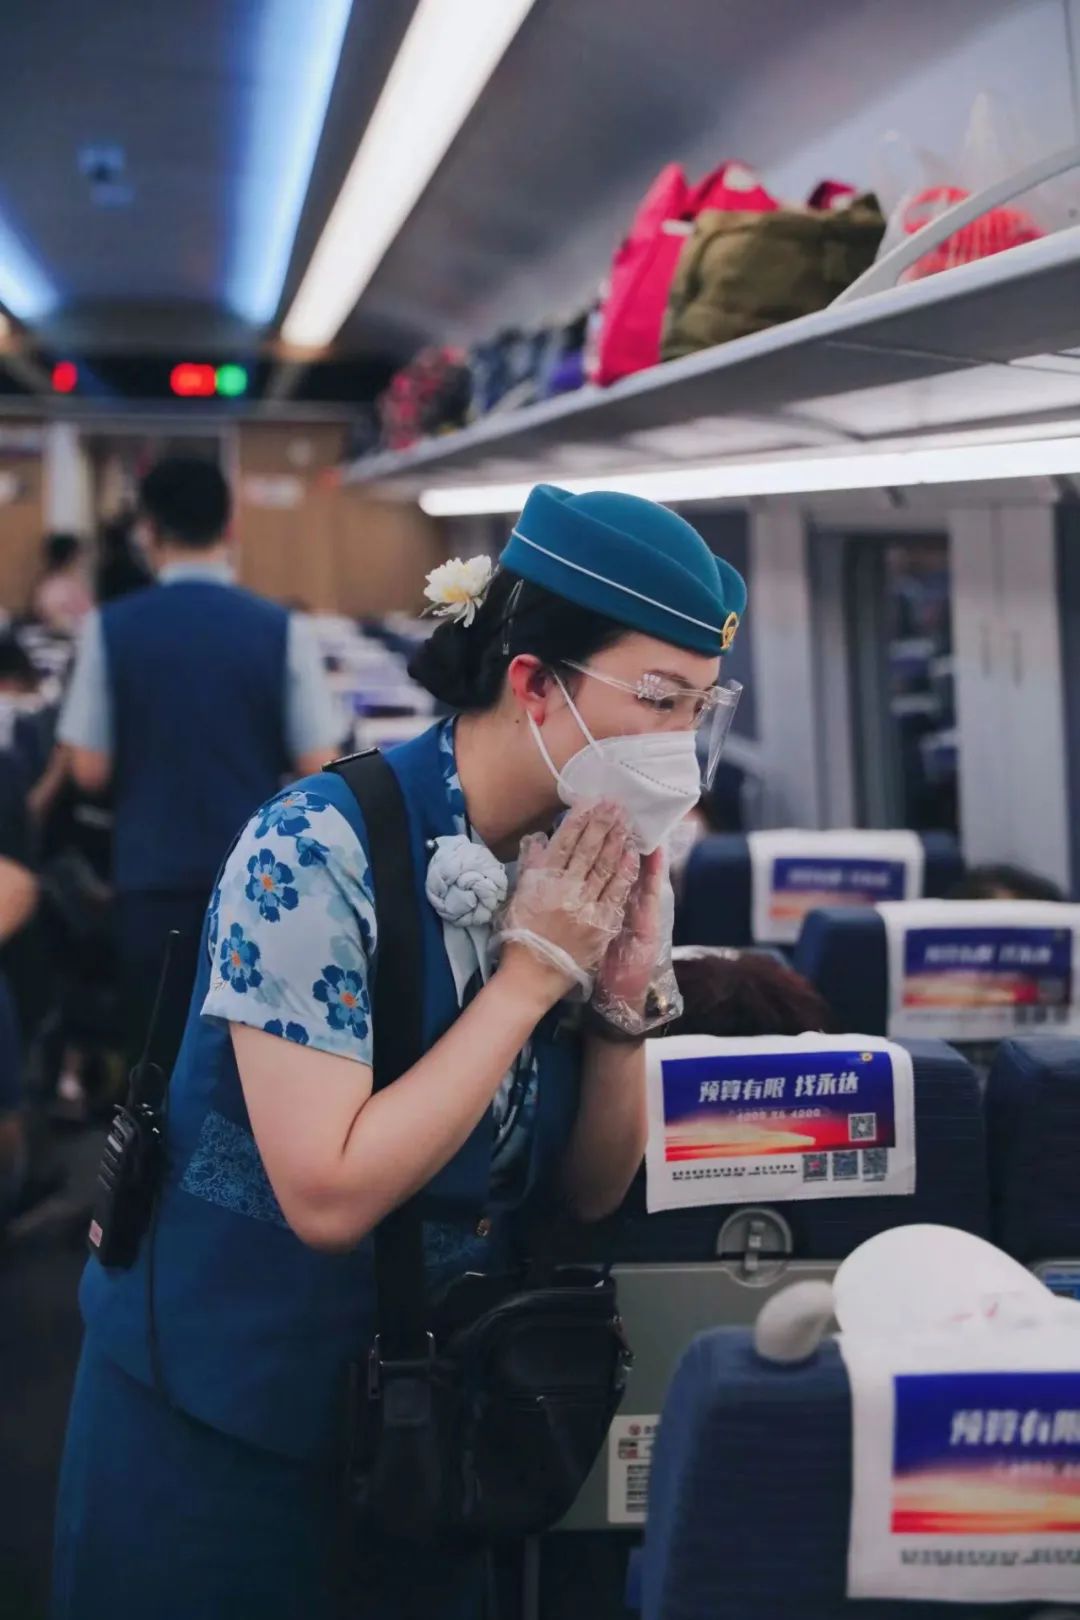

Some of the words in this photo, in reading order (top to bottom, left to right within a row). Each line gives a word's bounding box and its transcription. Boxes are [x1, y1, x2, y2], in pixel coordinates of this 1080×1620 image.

[699, 1077, 786, 1103] 预算有限
[795, 1071, 859, 1098] 找永达
